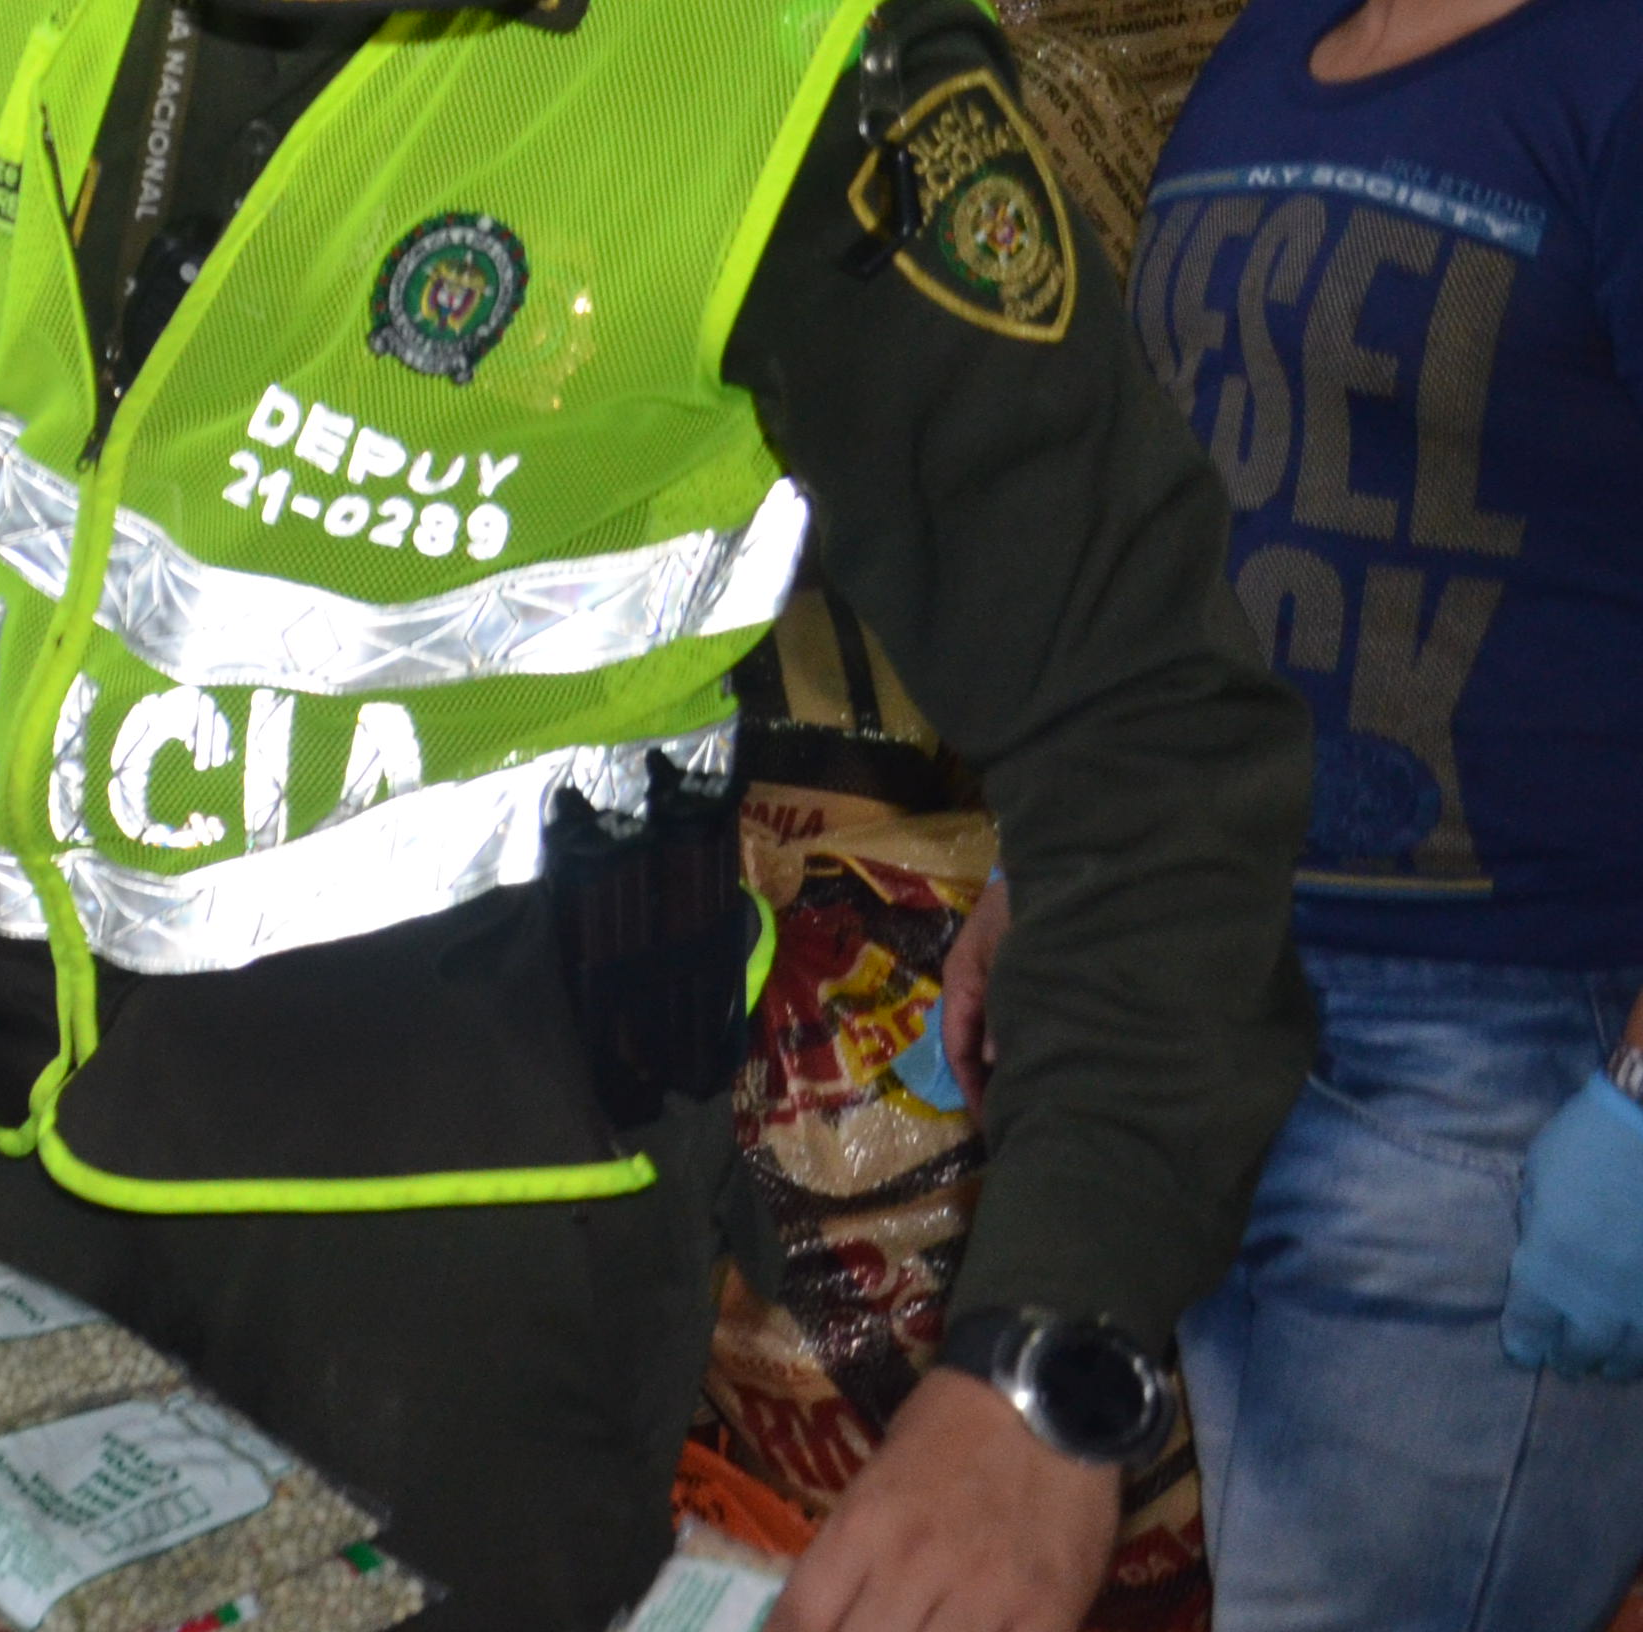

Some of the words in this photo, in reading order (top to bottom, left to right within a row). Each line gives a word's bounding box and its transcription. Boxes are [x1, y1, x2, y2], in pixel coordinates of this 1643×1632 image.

[134, 49, 187, 219] NACIONAL
[247, 382, 521, 500] DEPUY
[221, 448, 512, 561] 21-0289
